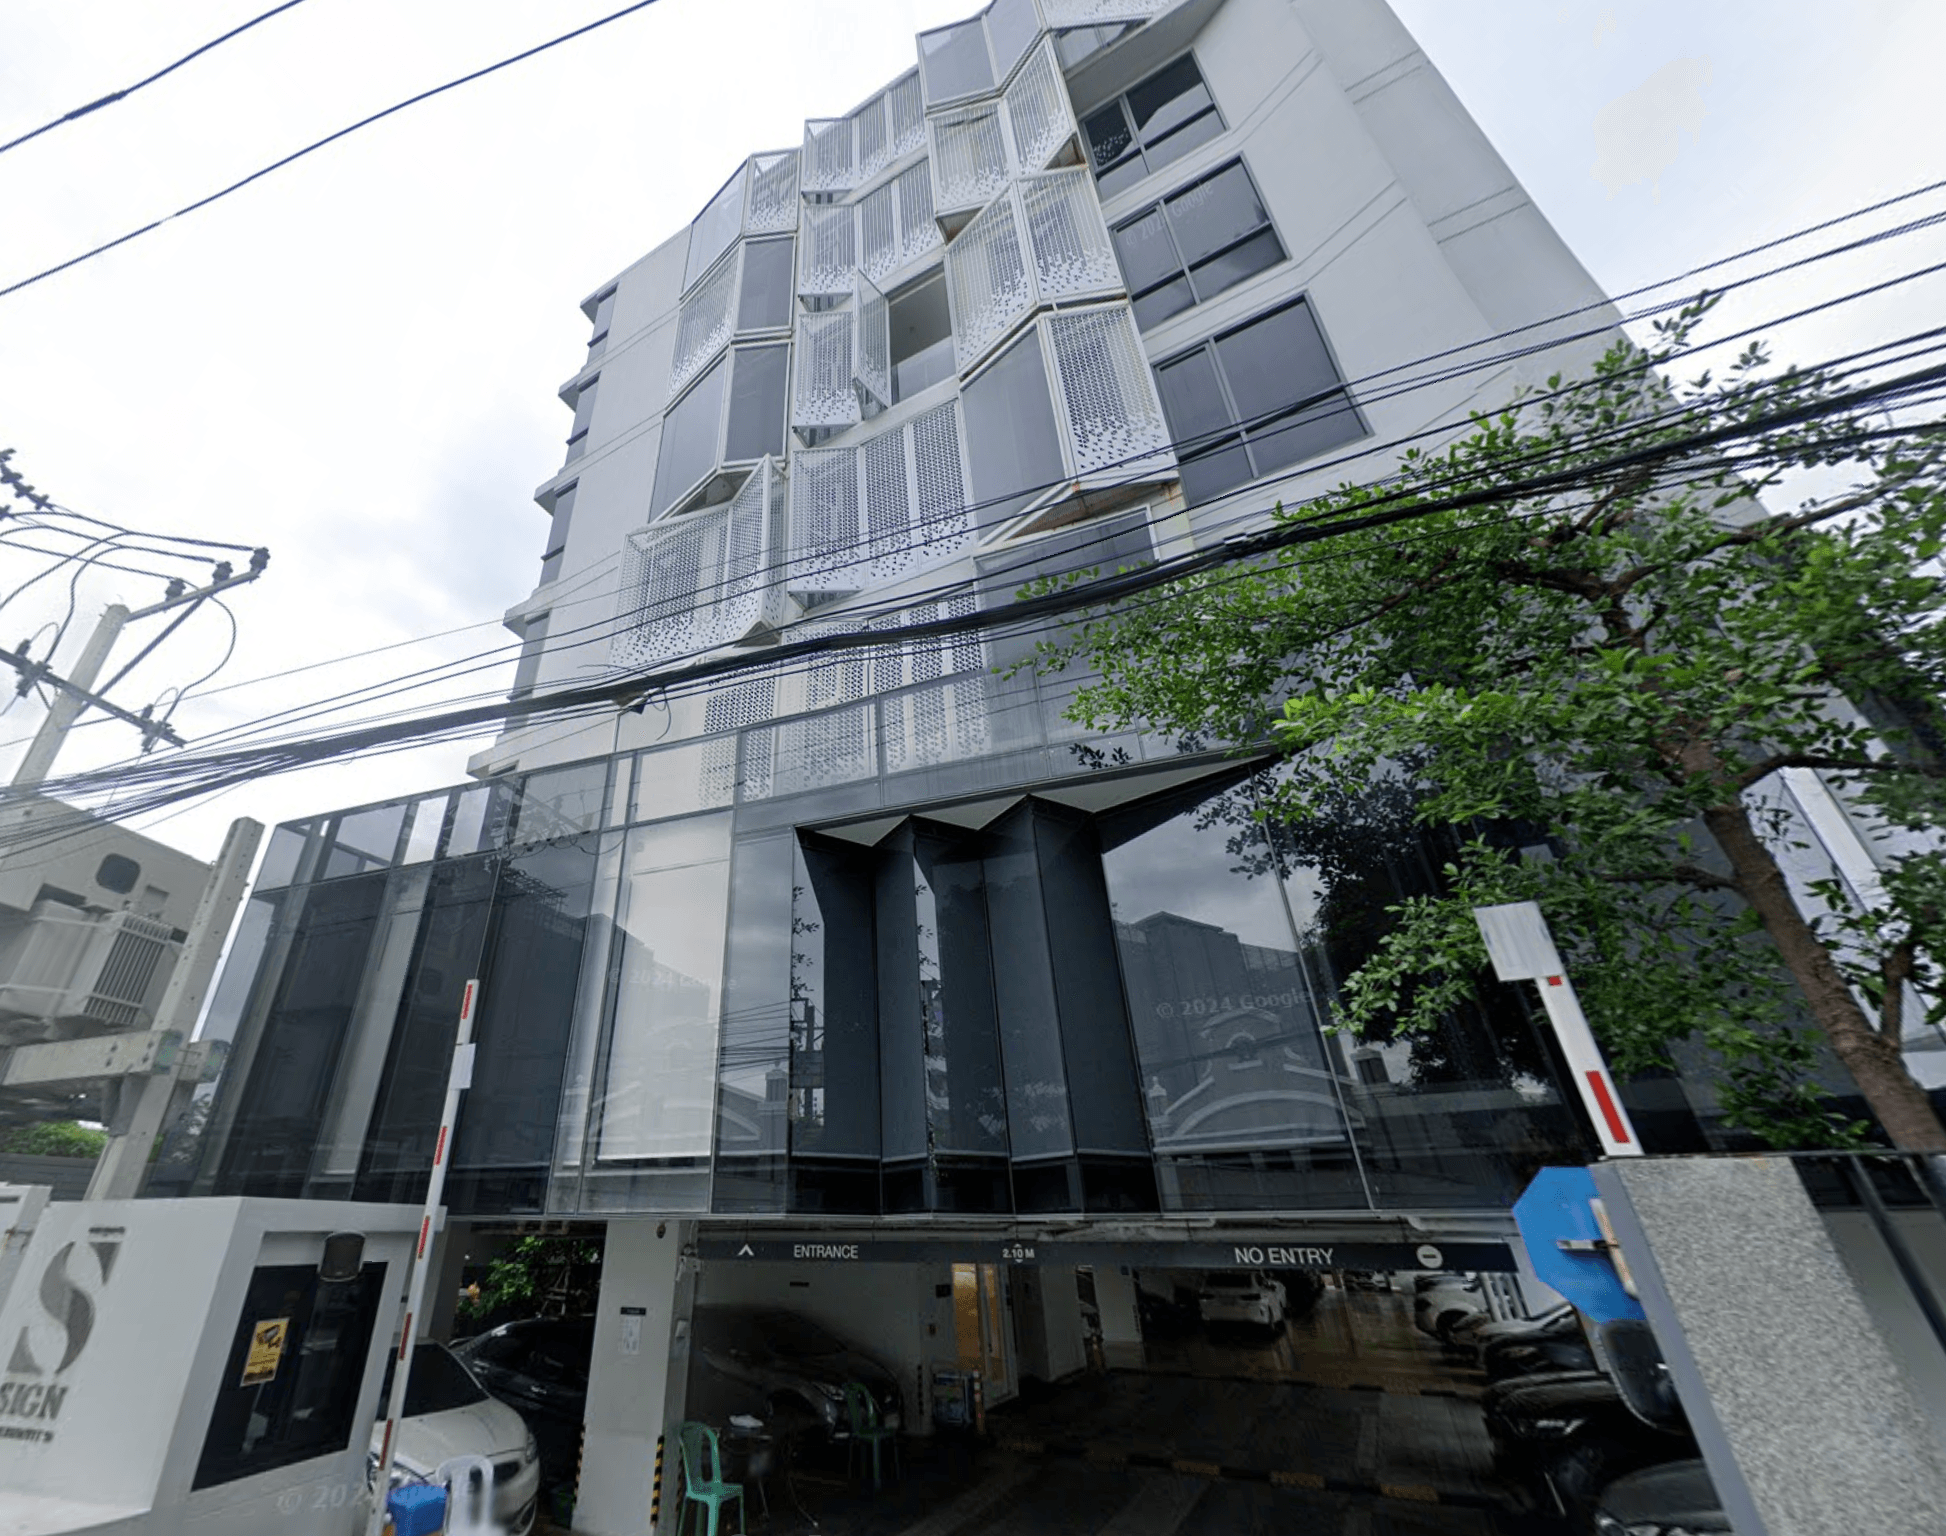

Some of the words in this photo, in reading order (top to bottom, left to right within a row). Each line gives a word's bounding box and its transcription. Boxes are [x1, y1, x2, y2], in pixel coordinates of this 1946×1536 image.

[794, 1244, 859, 1259] ENTRANCE
[1002, 1248, 1023, 1258] 2.10
[1024, 1248, 1036, 1259] M
[1234, 1246, 1264, 1265] NO
[1267, 1247, 1333, 1266] ENTRY
